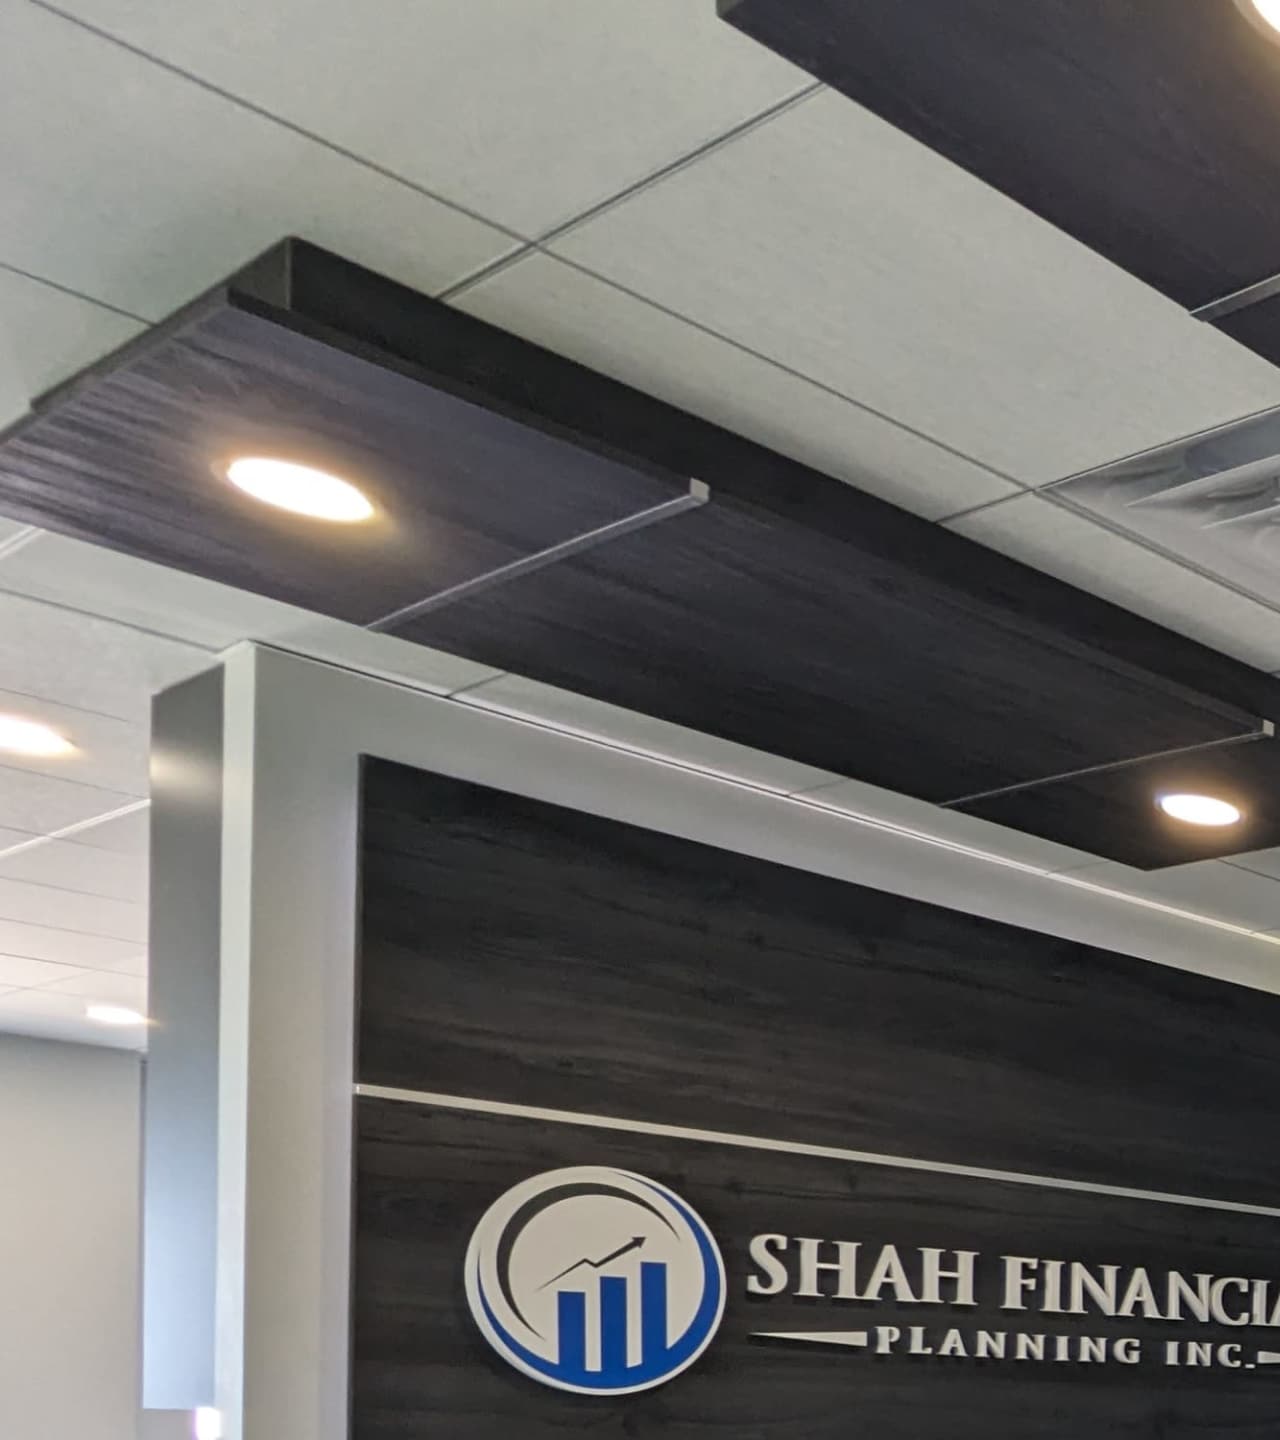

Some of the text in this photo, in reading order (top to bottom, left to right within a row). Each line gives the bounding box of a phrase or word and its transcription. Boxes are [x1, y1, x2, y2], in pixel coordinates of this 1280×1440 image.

[745, 1234, 979, 1306] SHAH
[875, 1326, 1255, 1369] PLANNING INC.
